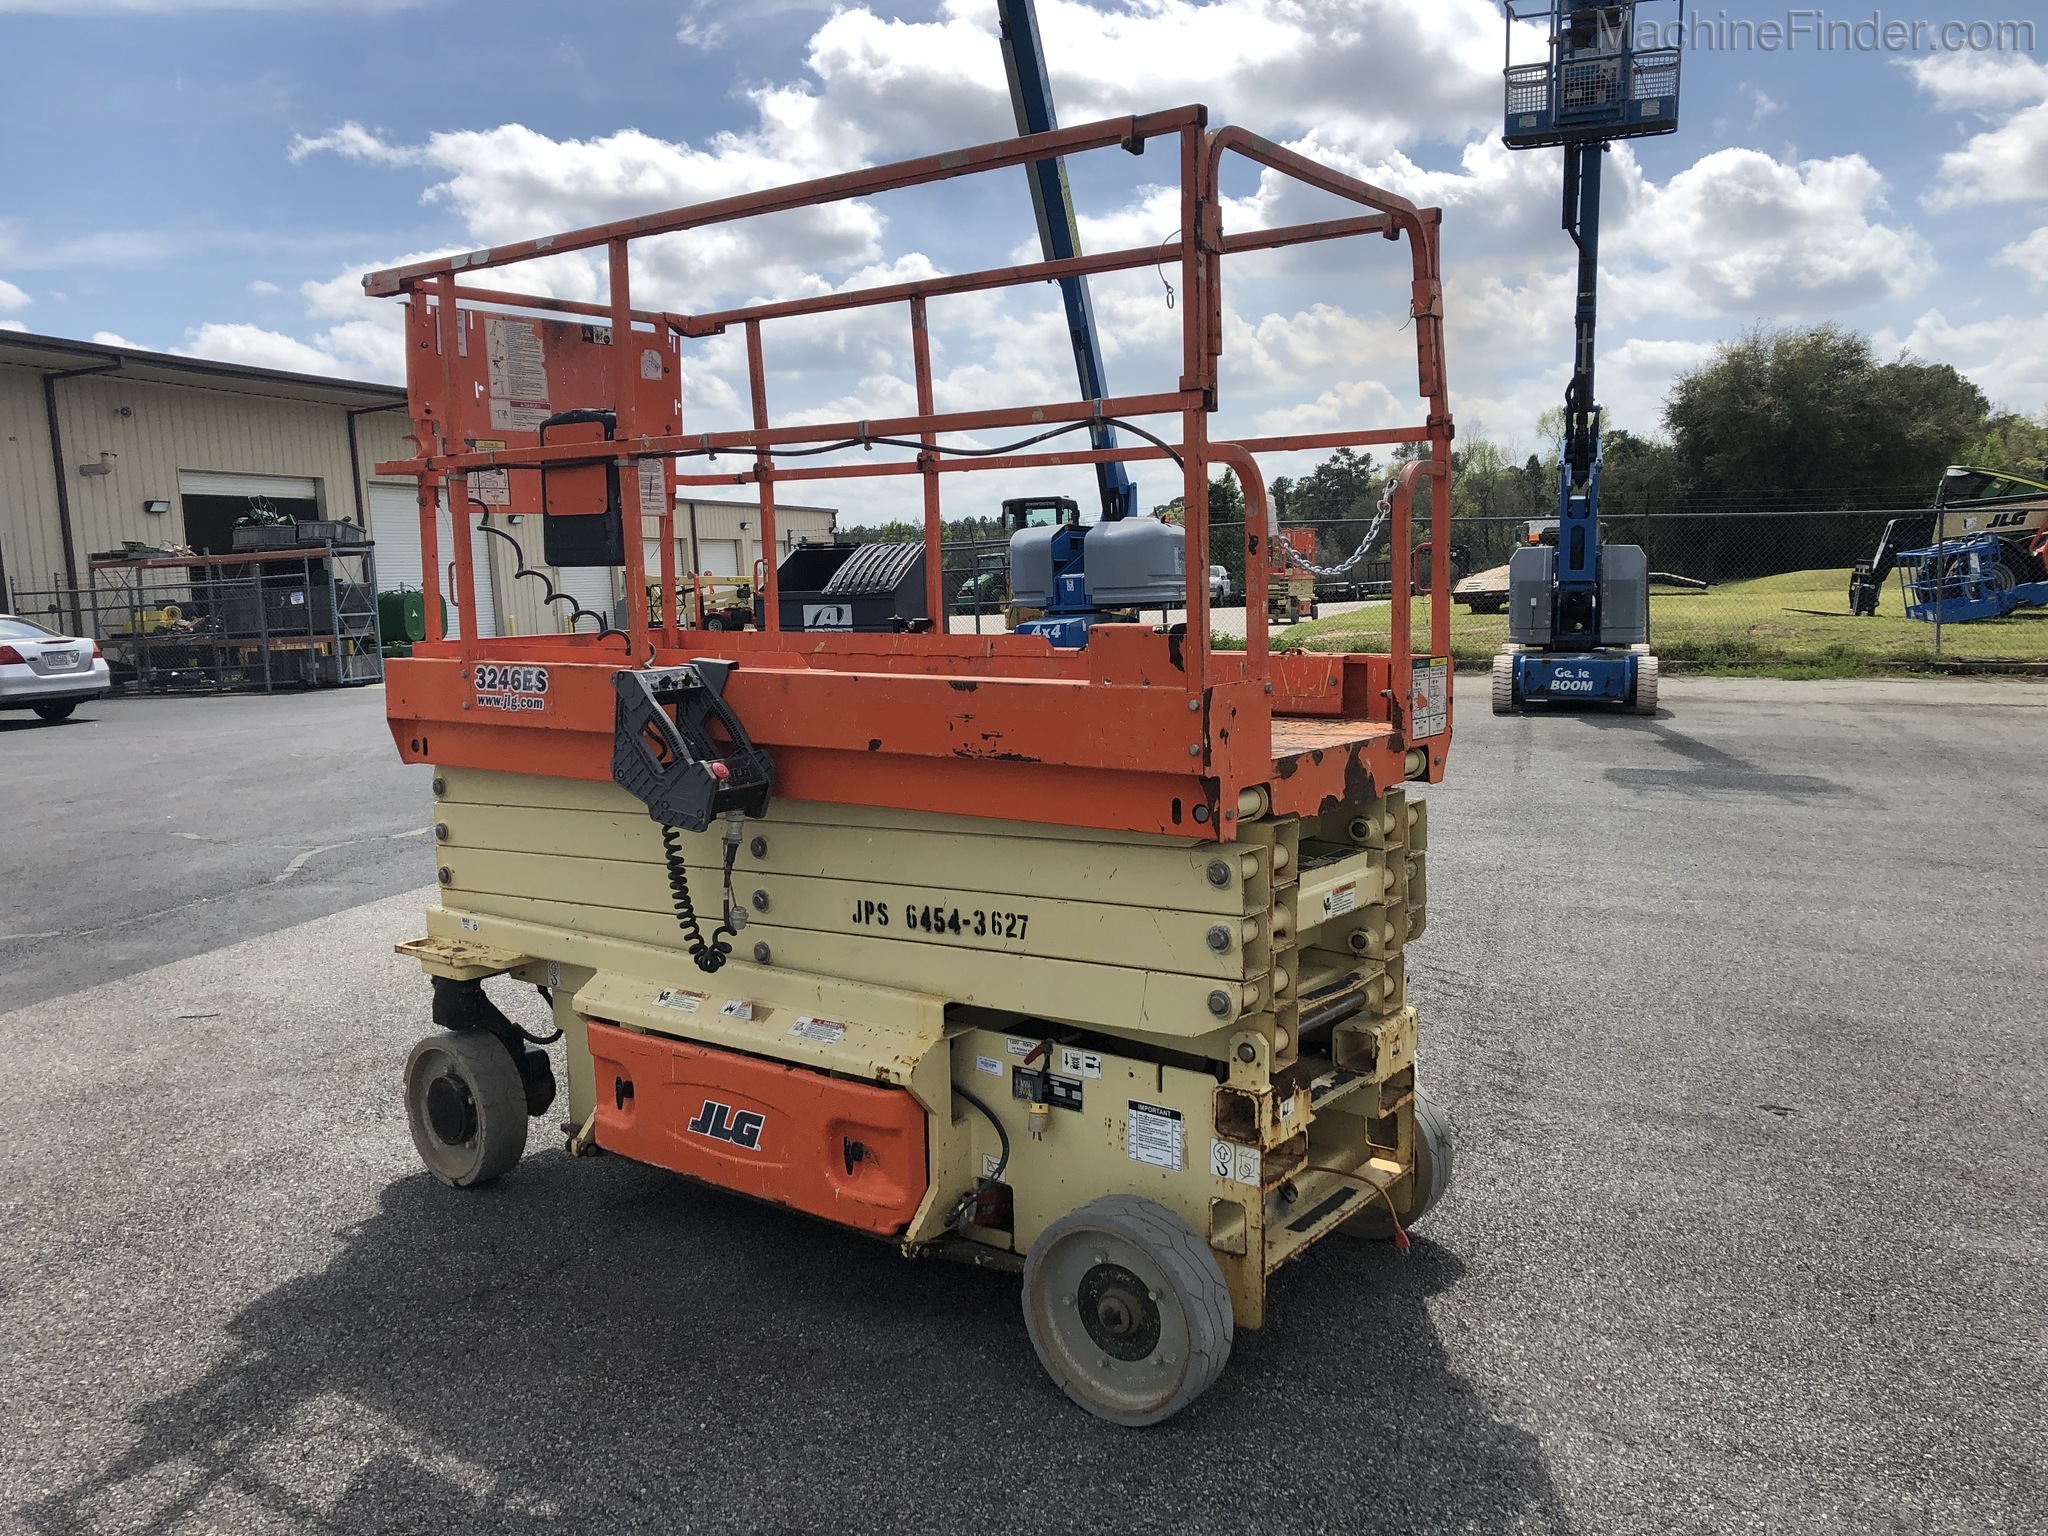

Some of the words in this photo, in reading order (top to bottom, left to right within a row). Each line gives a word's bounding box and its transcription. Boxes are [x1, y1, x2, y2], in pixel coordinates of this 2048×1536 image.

[1986, 510, 2028, 528] JLG
[1031, 624, 1061, 638] 4x4
[475, 667, 547, 692] 3246ES
[1550, 680, 1593, 691] BOOM
[477, 694, 543, 710] www.jlg.com
[852, 899, 889, 926] JPS
[905, 904, 1029, 940] 6454-3627
[1137, 1103, 1171, 1117] IMPORTANT
[688, 1100, 766, 1150] JLG
